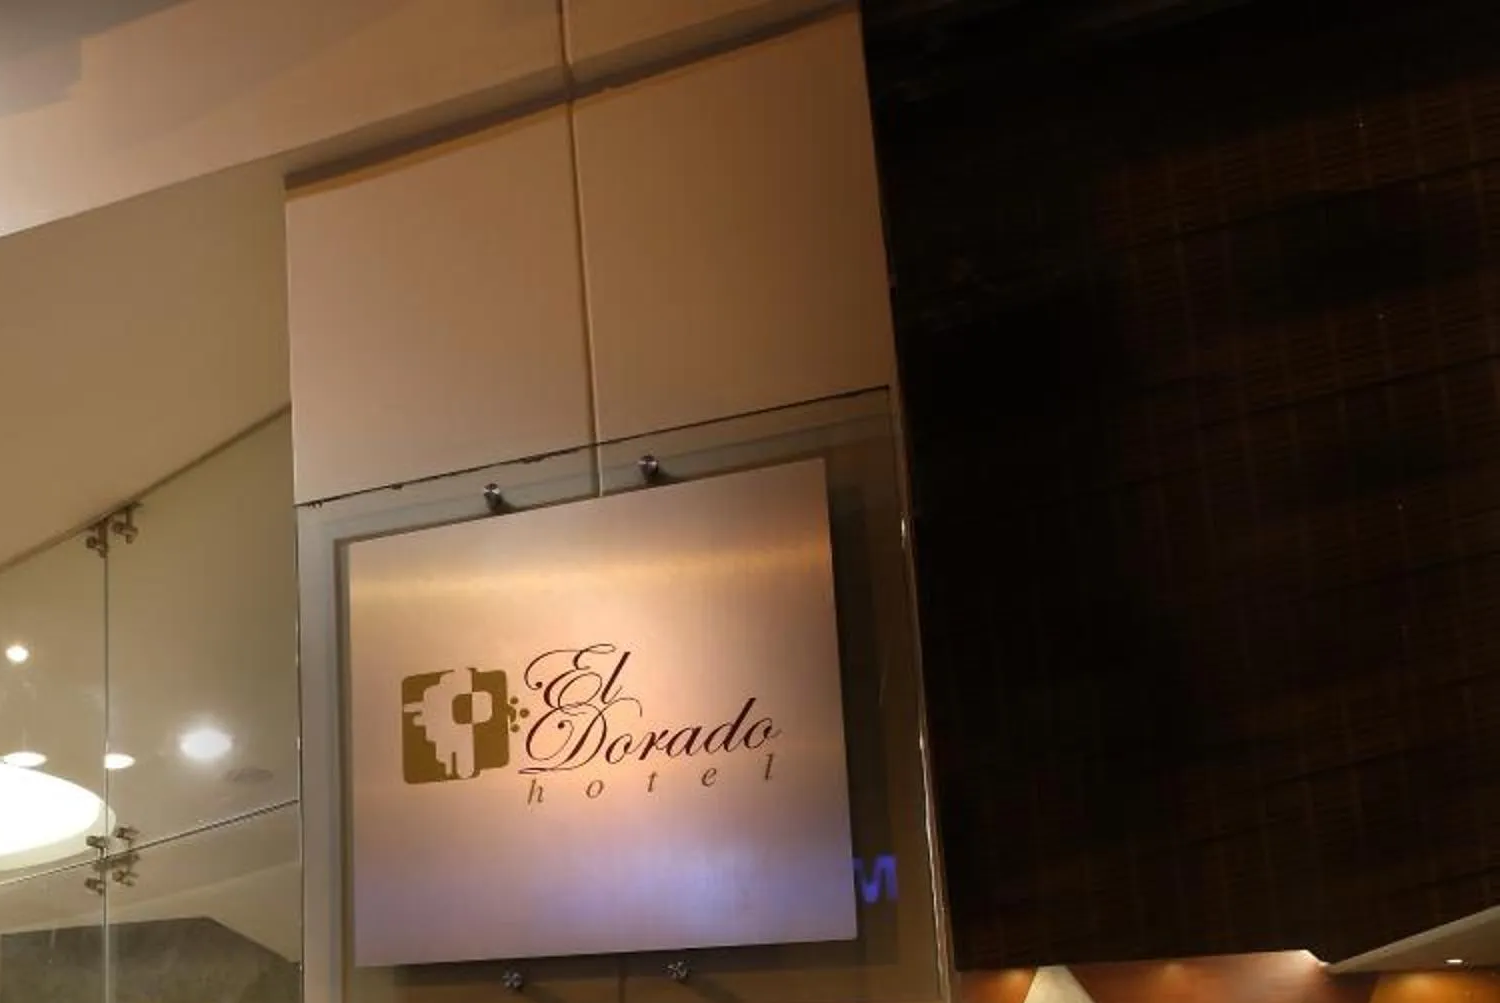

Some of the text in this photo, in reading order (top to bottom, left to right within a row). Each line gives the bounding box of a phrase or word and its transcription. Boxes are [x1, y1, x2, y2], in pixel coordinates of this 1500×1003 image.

[523, 643, 632, 715] El
[518, 697, 781, 774] Dorado
[526, 752, 773, 805] hotel
